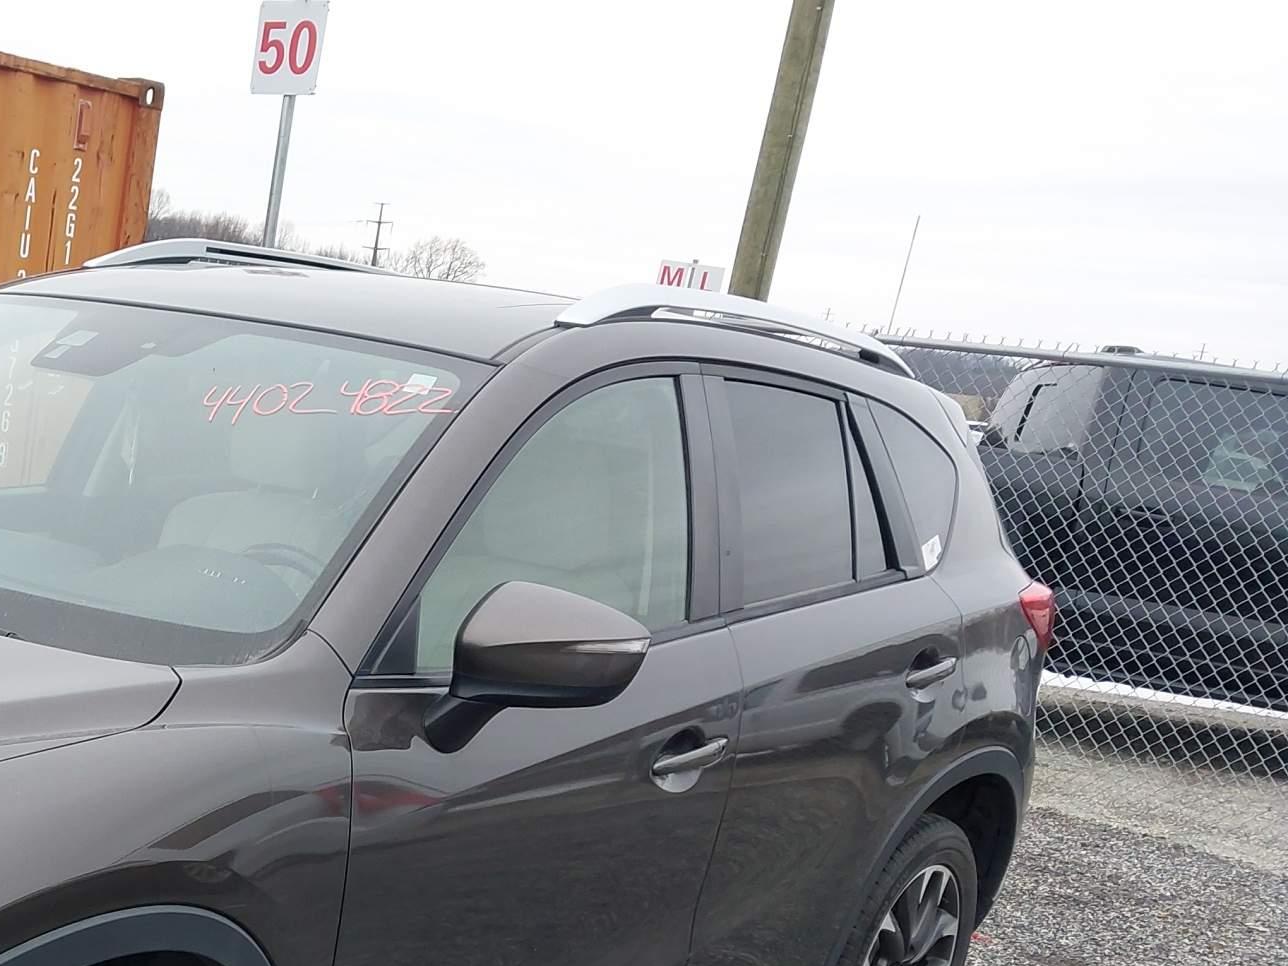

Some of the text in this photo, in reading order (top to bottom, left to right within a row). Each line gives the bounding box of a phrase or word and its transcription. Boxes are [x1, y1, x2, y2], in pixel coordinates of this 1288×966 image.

[258, 20, 317, 75] 50
[65, 157, 83, 265] 22G1
[203, 378, 454, 425] 4402 4822
